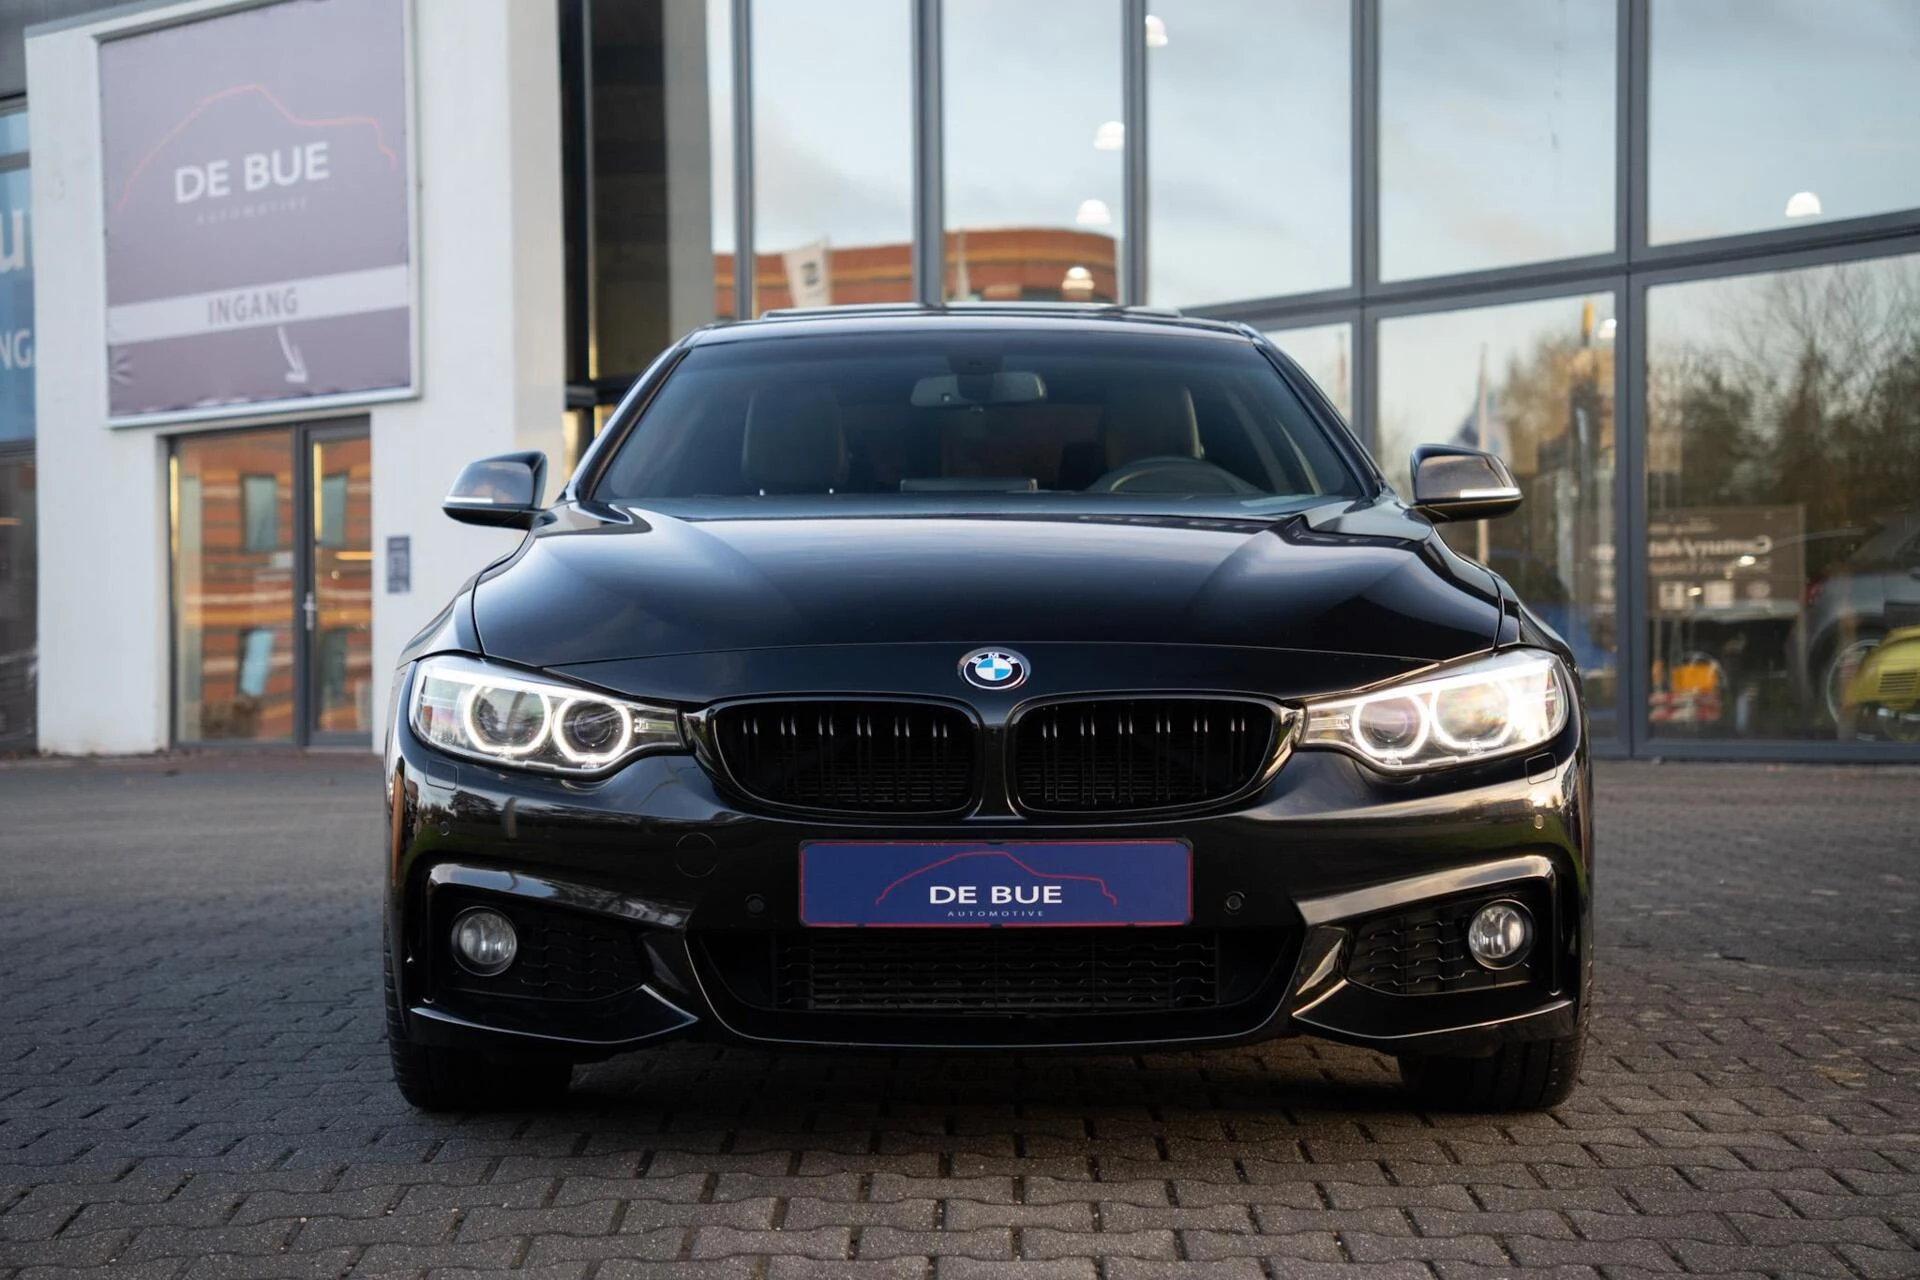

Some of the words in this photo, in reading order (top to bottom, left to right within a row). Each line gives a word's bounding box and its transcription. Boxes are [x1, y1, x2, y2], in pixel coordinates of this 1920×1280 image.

[175, 160, 231, 204] DE
[244, 141, 330, 191] BUE
[208, 286, 298, 325] INGANG
[970, 653, 1019, 664] BMW
[930, 886, 977, 904] DE
[991, 886, 1062, 904] BUE
